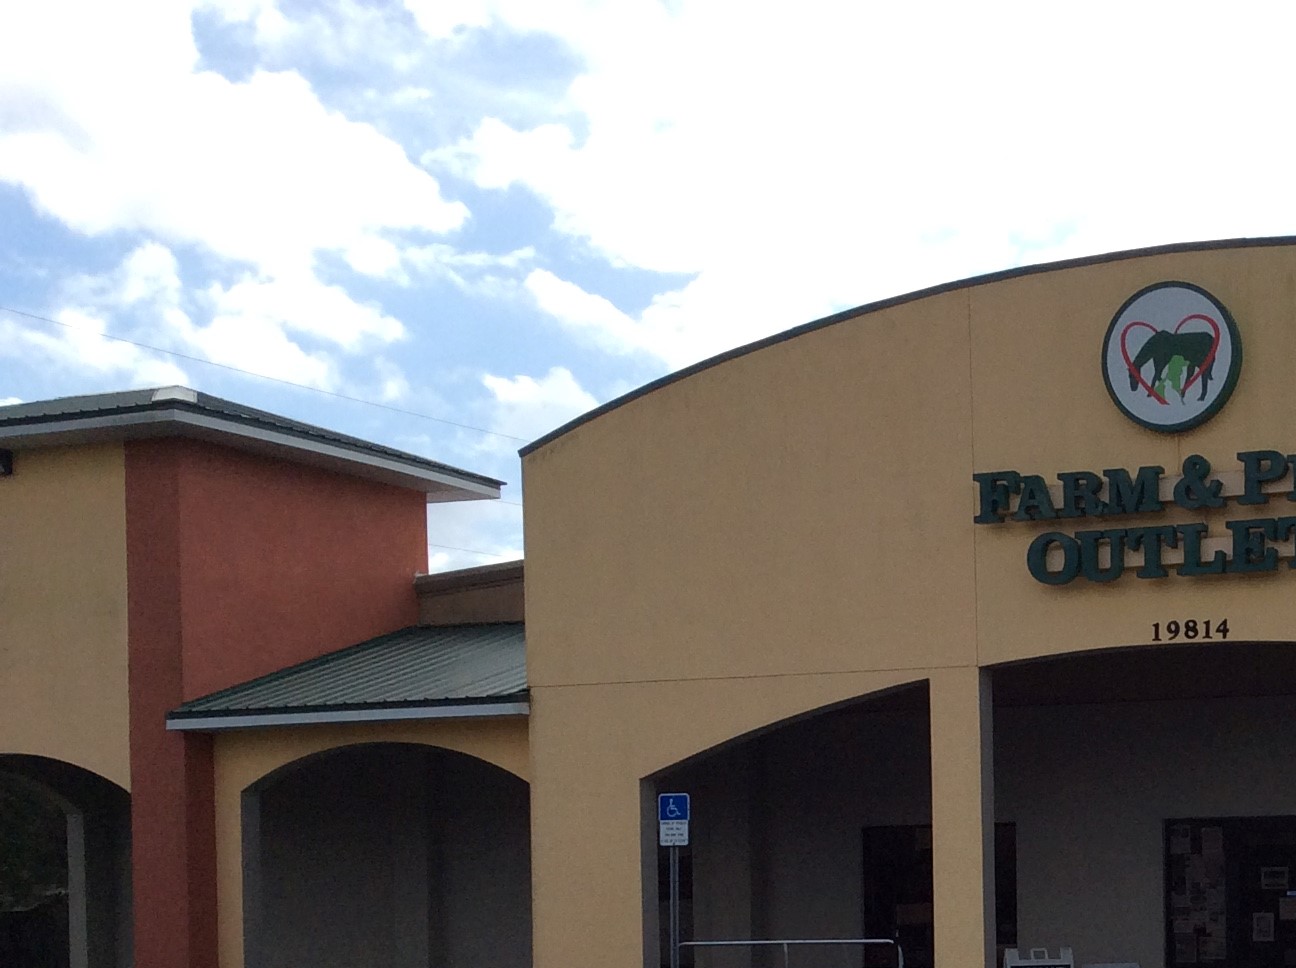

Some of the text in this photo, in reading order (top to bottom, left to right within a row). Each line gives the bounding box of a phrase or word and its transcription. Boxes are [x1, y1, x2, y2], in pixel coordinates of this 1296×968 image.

[973, 465, 1166, 524] FARM
[1173, 454, 1225, 510] &
[1151, 618, 1230, 641] 19814
